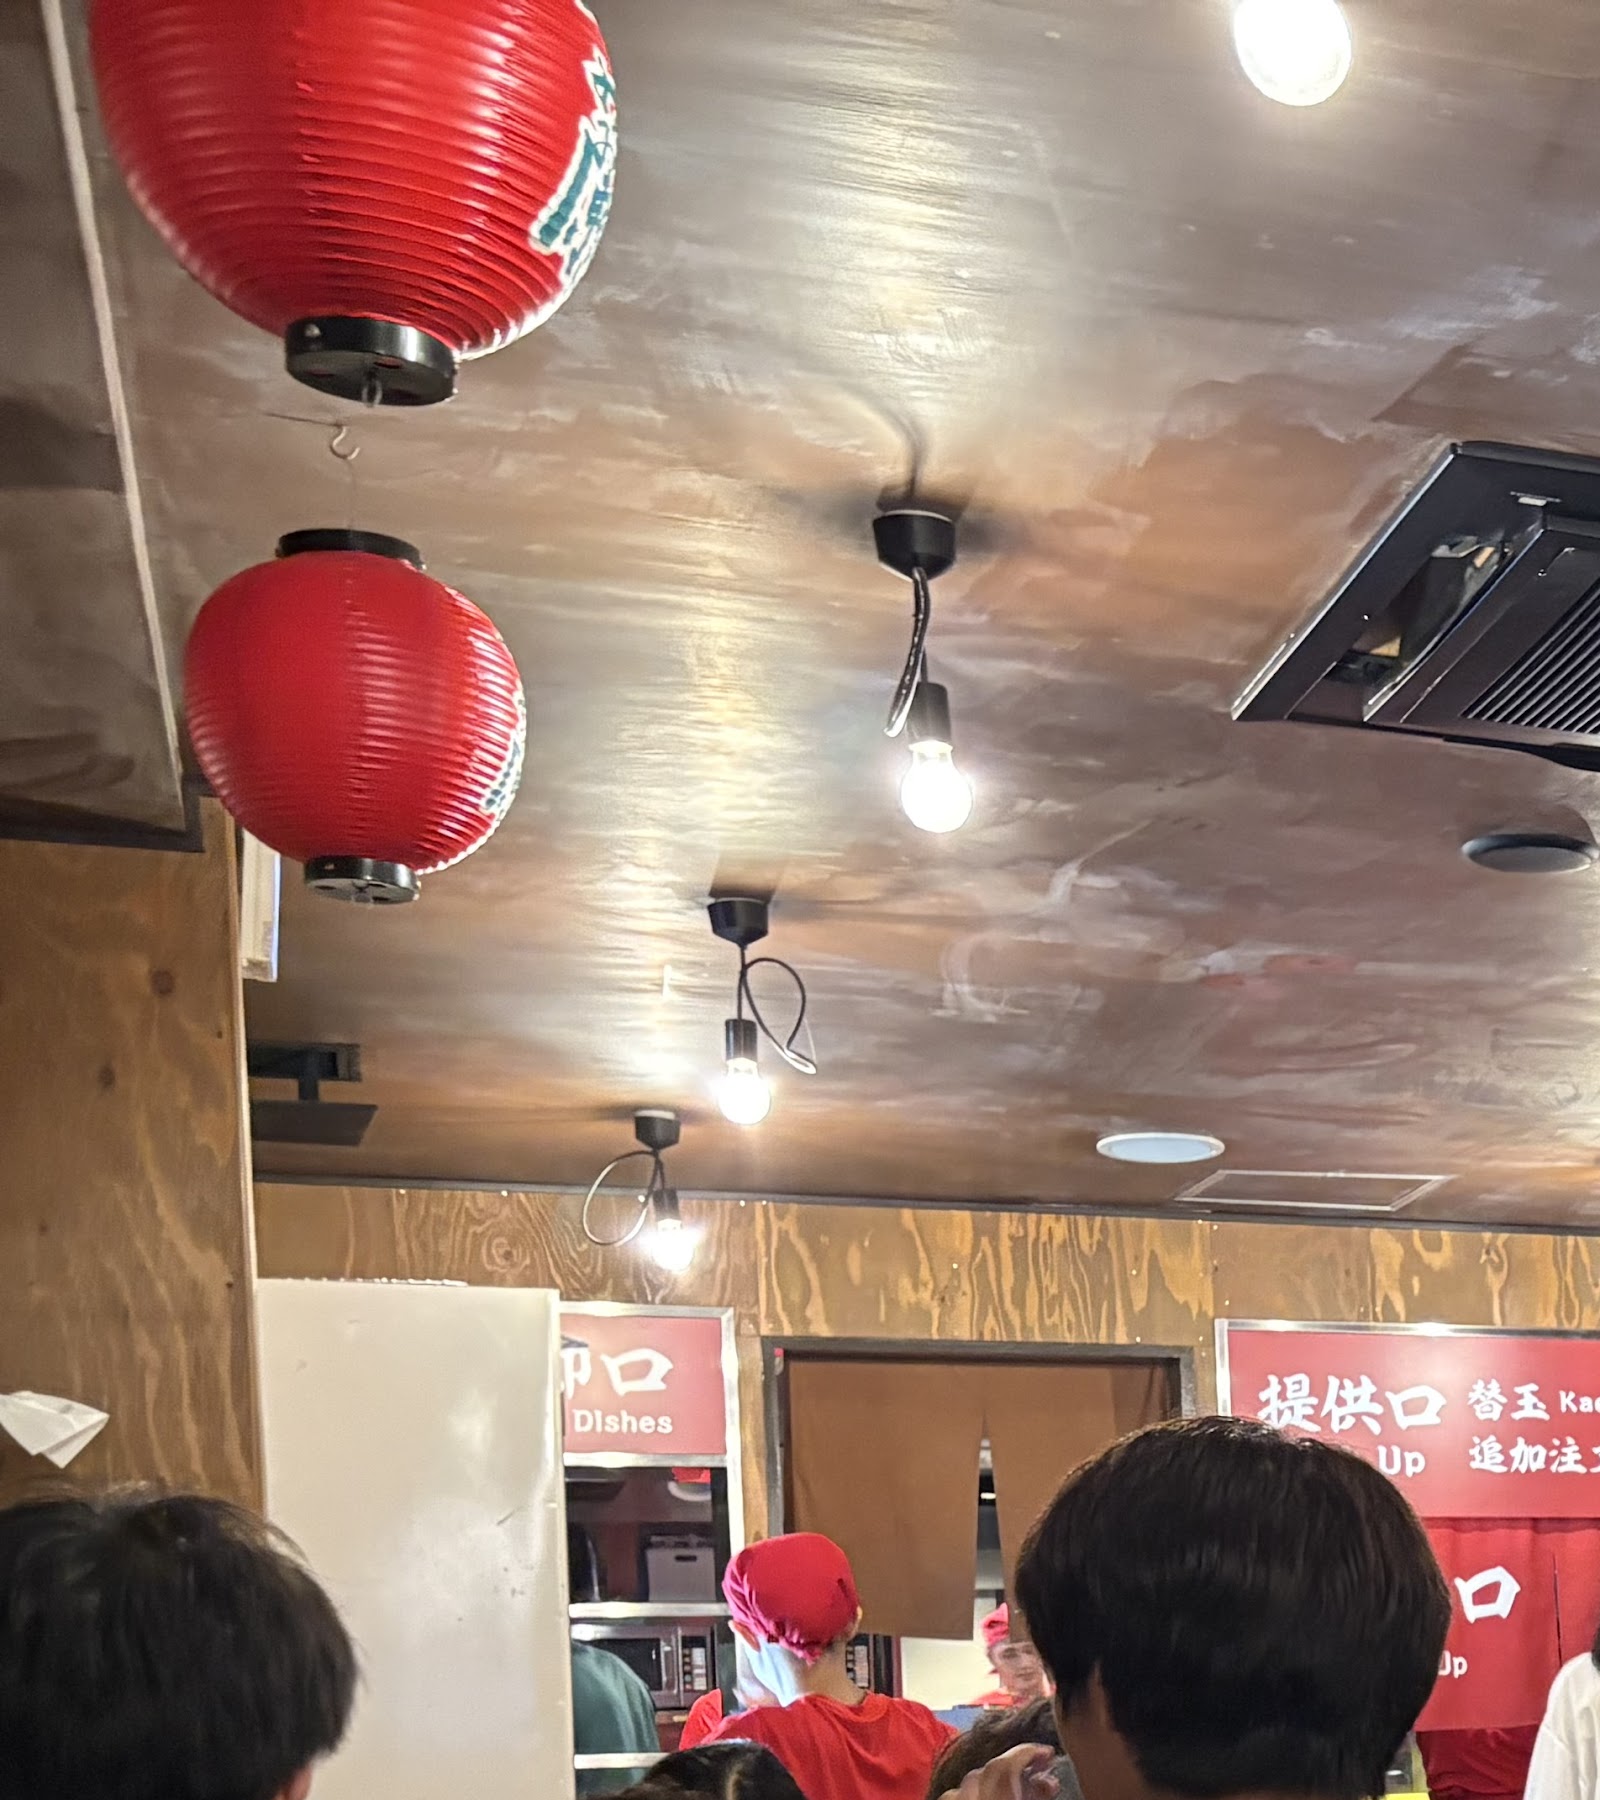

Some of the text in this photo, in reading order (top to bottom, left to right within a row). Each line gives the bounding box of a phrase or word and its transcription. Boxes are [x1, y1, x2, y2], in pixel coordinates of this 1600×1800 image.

[572, 1408, 673, 1434] Dishes
[1257, 1373, 1447, 1436] 提供口
[1467, 1378, 1551, 1421] 替玉
[1377, 1444, 1426, 1478] Up
[1454, 1565, 1521, 1624] 口
